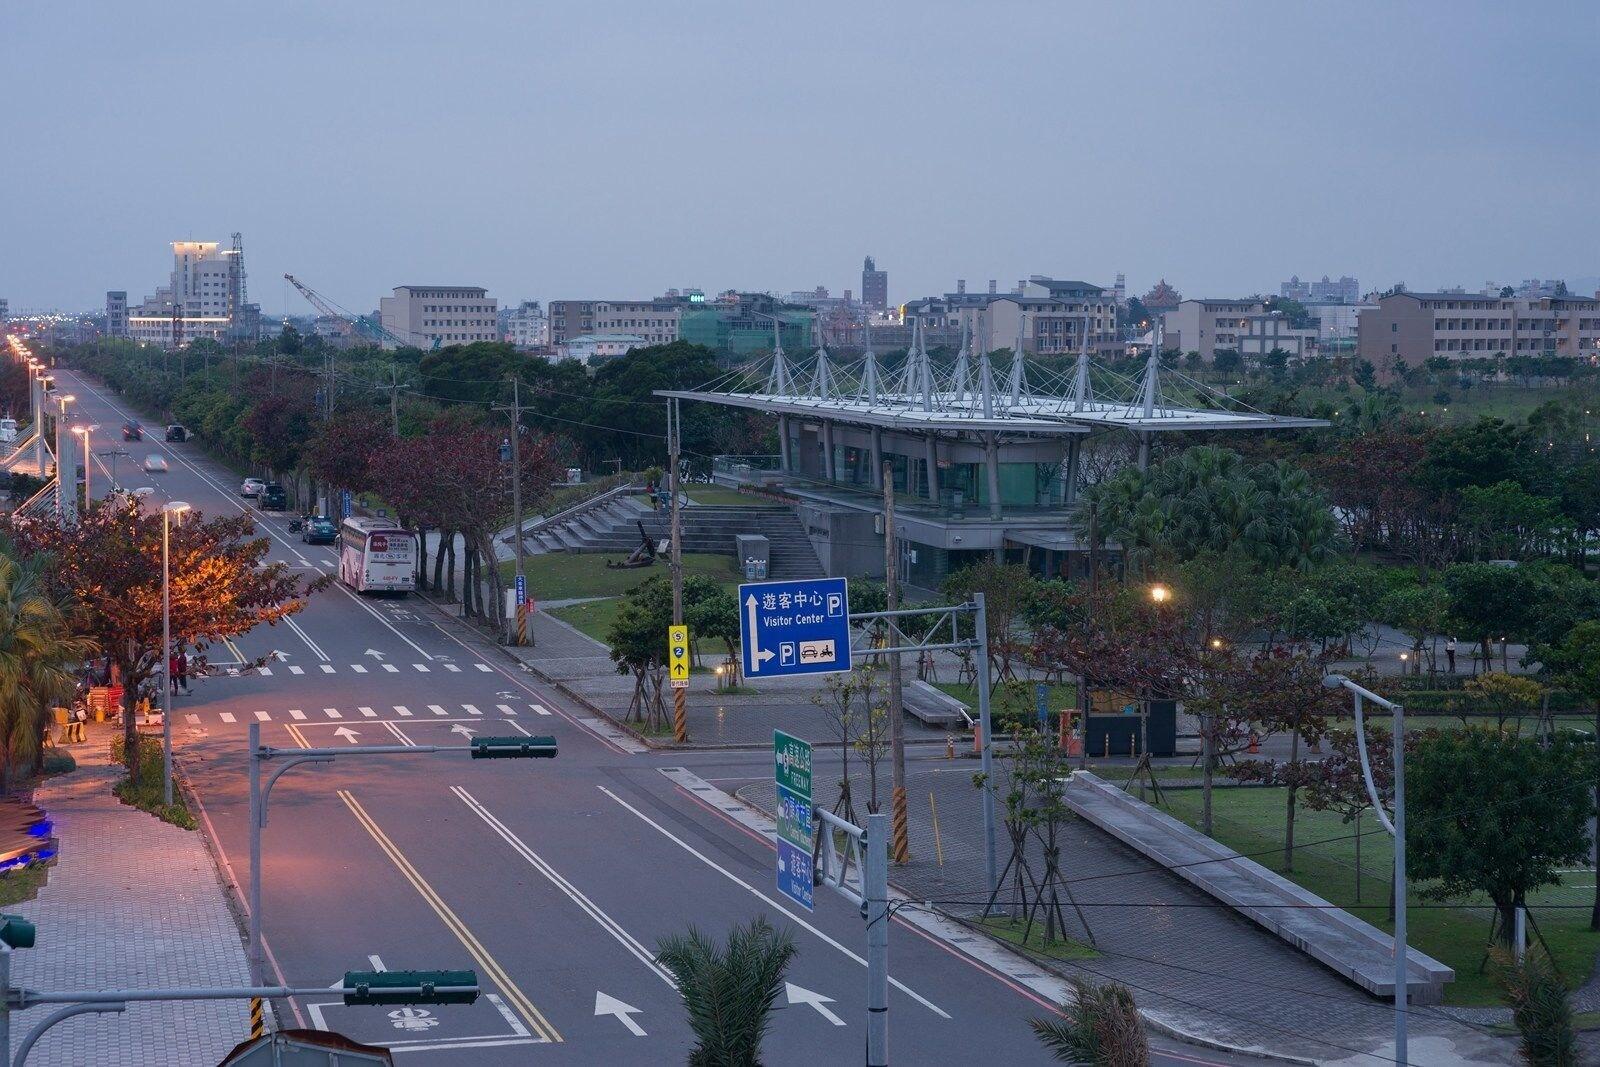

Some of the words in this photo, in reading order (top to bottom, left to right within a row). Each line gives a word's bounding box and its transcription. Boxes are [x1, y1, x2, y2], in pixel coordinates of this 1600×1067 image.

[762, 590, 823, 610] 遊客中心
[763, 616, 792, 627] Visitor
[795, 614, 824, 625] Center
